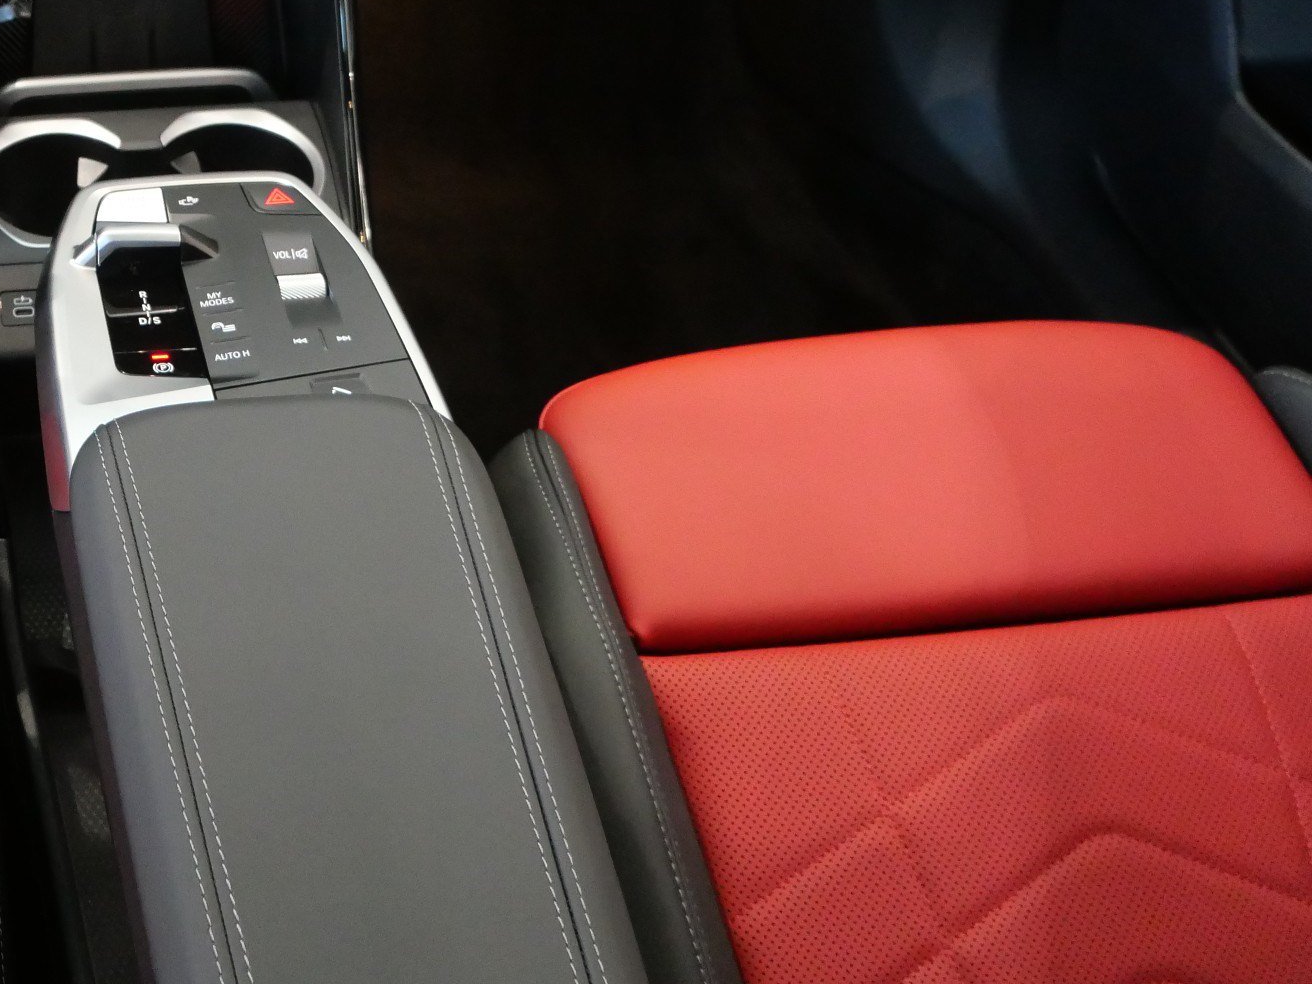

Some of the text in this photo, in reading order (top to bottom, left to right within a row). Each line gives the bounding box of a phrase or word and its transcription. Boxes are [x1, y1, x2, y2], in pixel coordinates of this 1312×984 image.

[273, 250, 292, 260] VOL
[138, 291, 147, 299] R
[206, 291, 221, 300] MY
[142, 303, 152, 311] N
[199, 297, 234, 308] MODES
[214, 349, 250, 361] AUTO H
